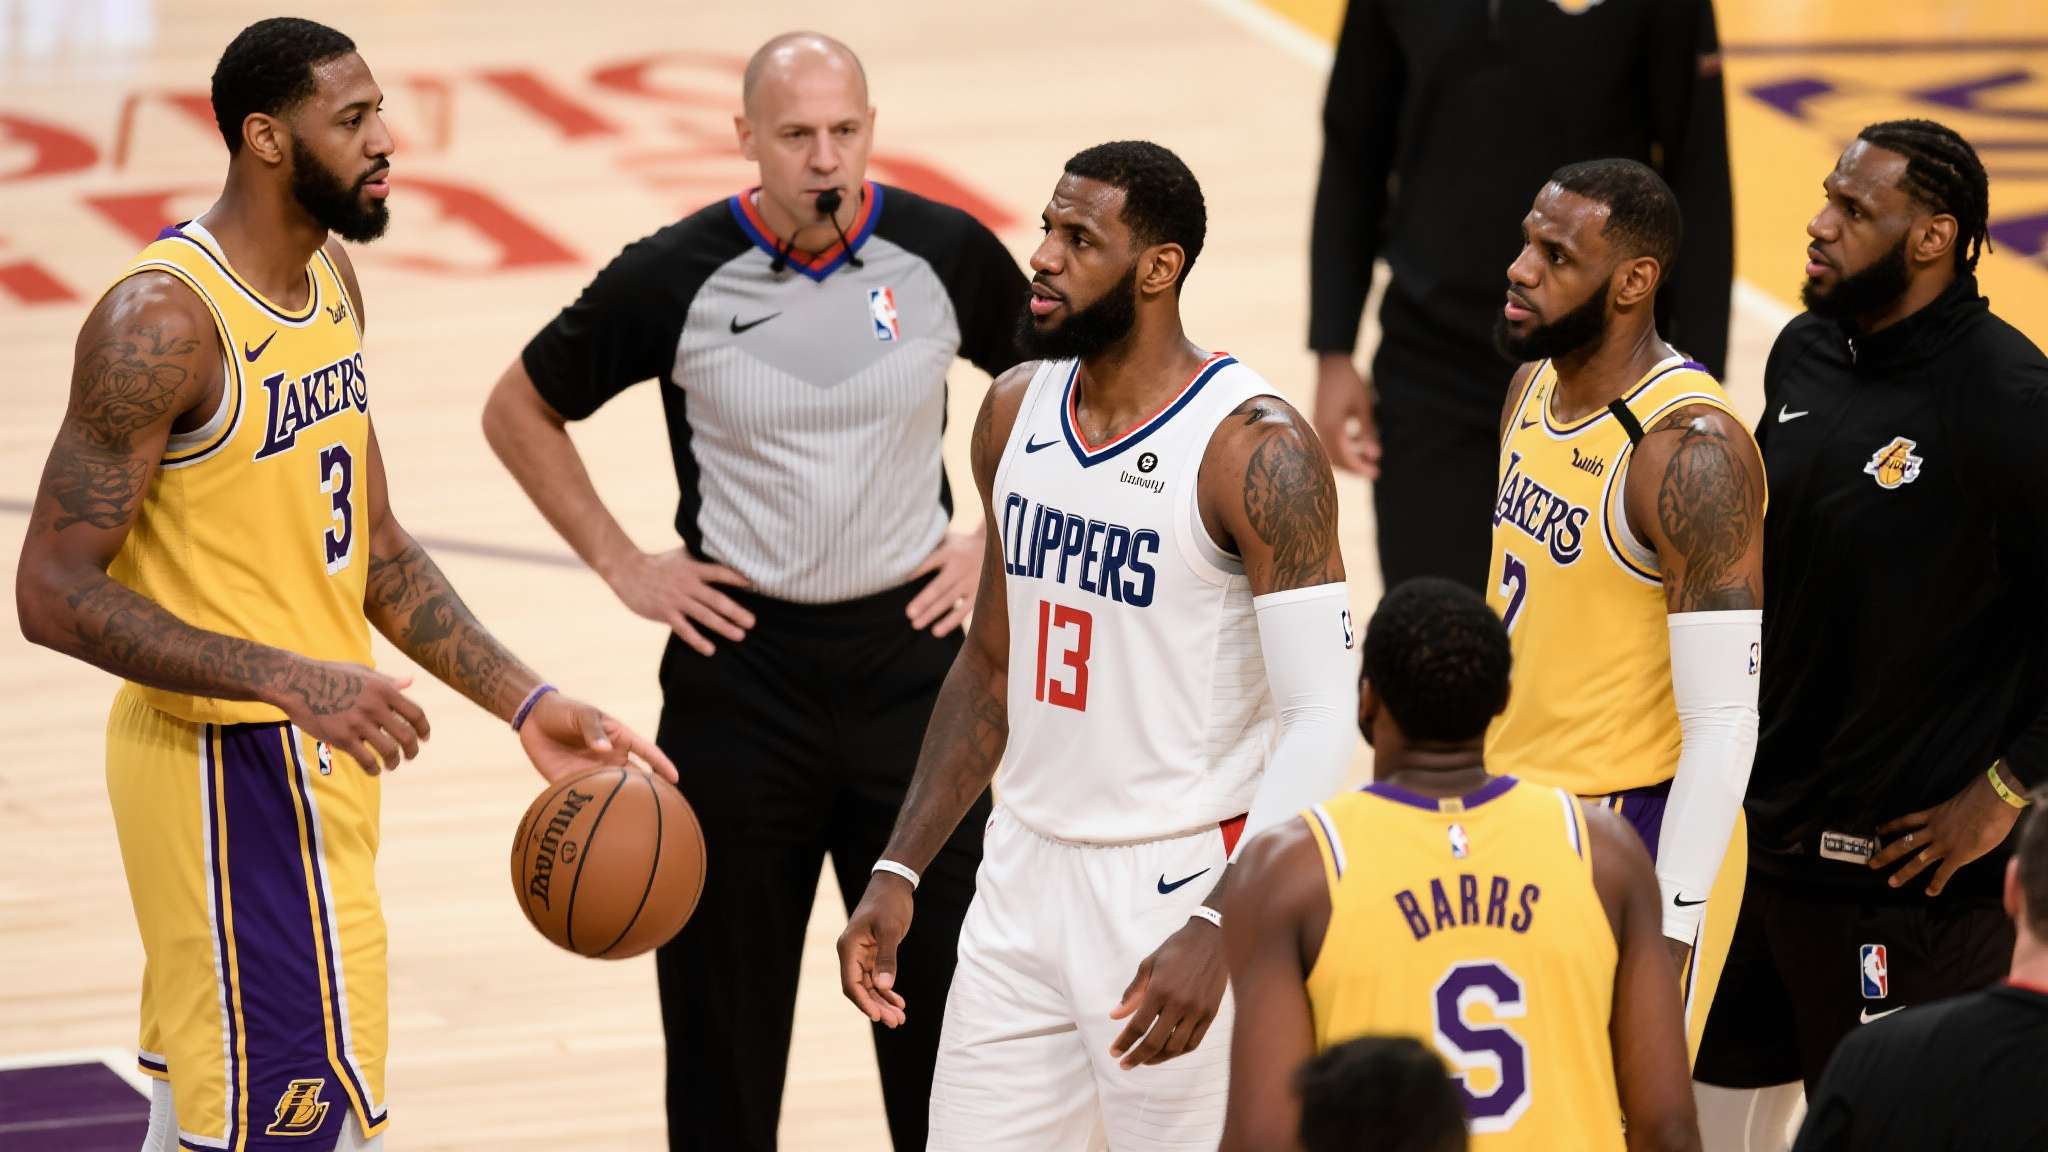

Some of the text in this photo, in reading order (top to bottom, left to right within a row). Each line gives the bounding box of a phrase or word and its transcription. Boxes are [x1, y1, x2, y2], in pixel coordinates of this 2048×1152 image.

[254, 352, 368, 462] LAKERS
[319, 443, 353, 573] 3
[1003, 492, 1160, 608] CLIPPERS
[1036, 599, 1093, 712] 13
[1395, 874, 1540, 942] BARRS
